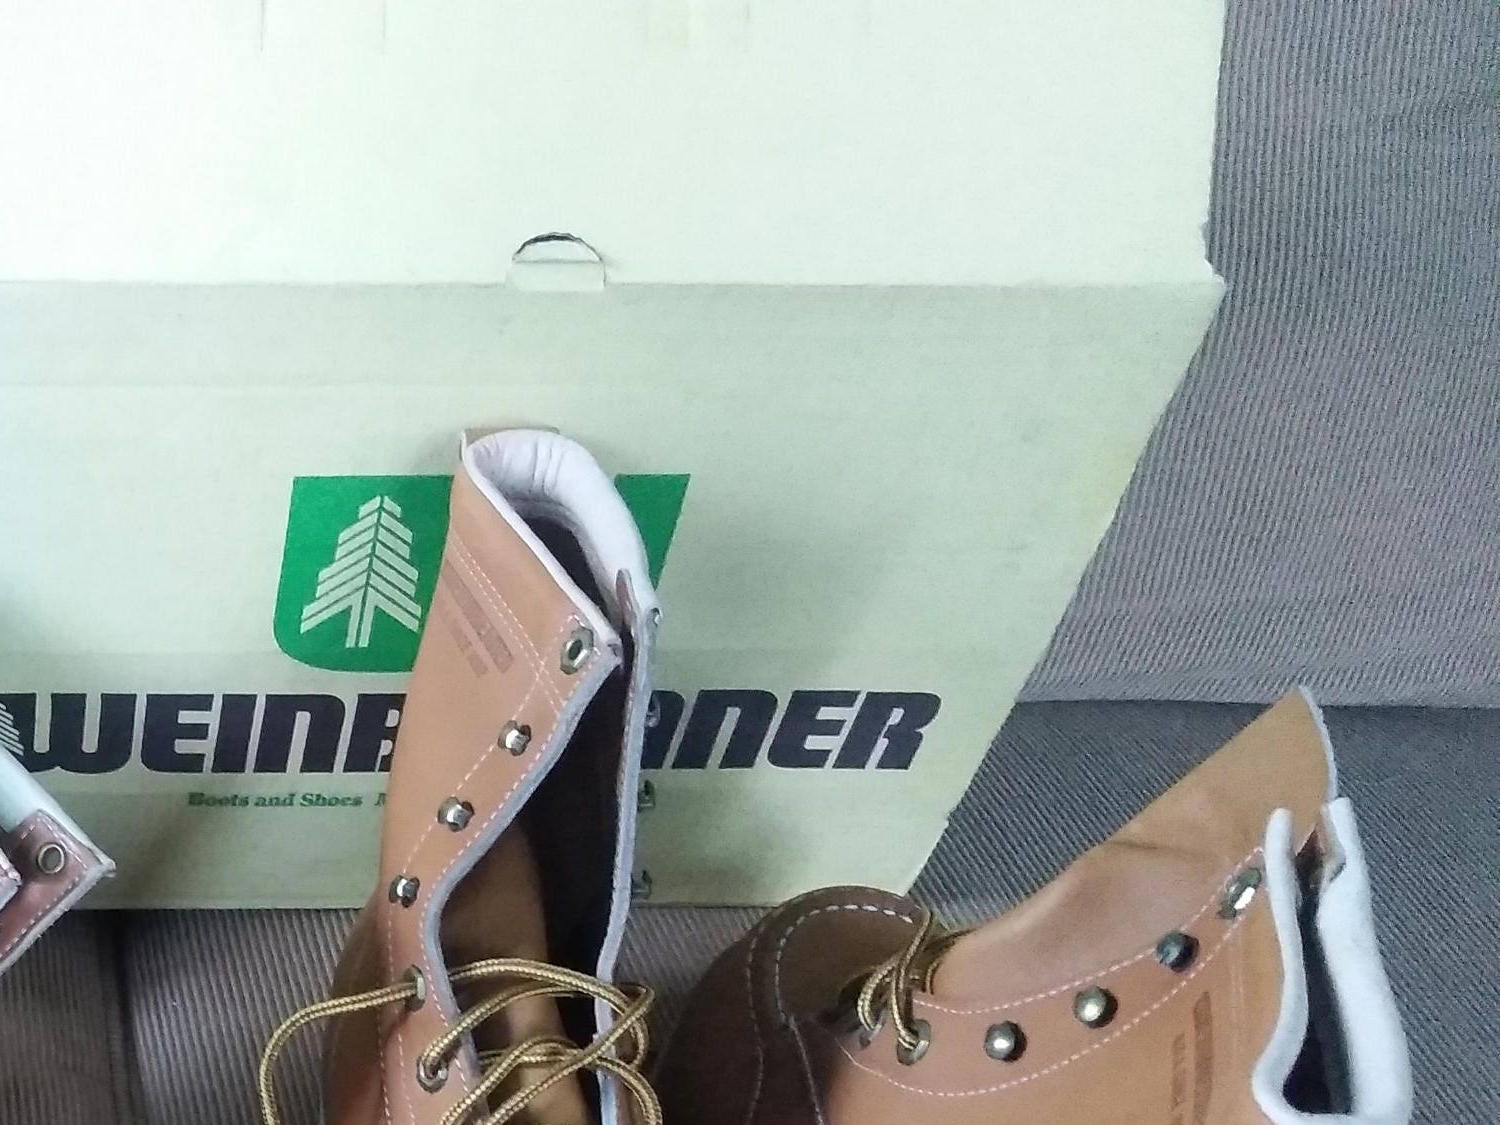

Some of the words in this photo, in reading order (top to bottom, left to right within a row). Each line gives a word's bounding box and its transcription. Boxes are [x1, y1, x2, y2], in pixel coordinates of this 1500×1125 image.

[187, 792, 249, 808] Boots
[253, 792, 296, 808] and
[299, 792, 364, 808] Shoes
